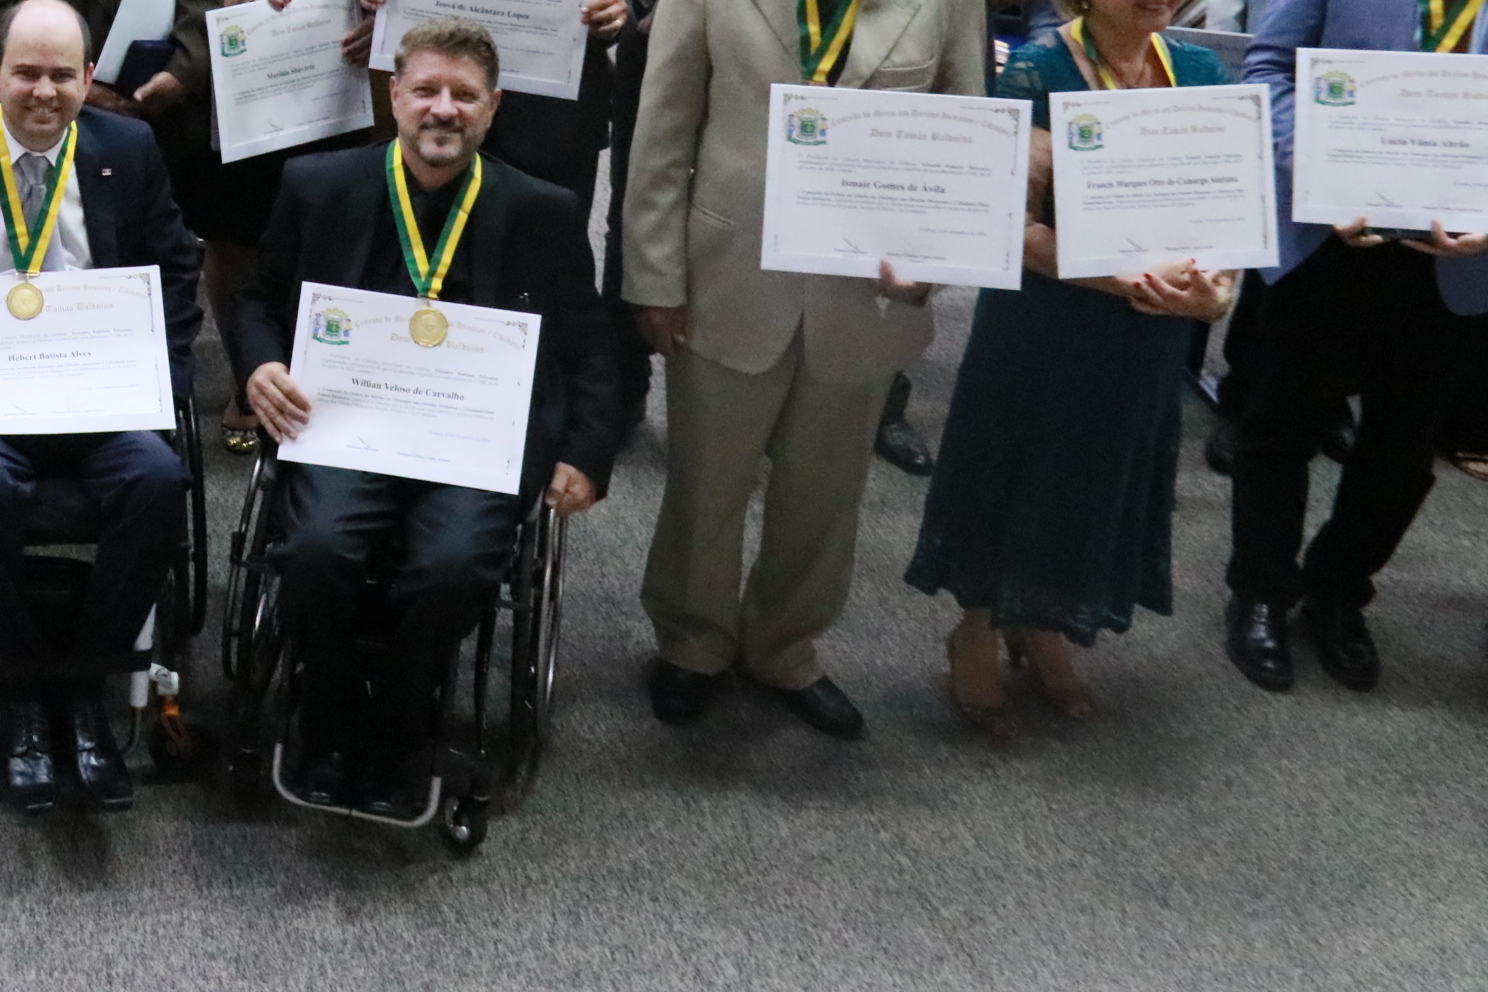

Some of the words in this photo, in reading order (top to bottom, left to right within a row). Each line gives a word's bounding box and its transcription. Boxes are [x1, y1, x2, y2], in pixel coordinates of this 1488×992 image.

[435, 0, 456, 11] Jeová
[469, 5, 505, 16] Alcântara
[507, 10, 530, 20] Lopes
[841, 179, 870, 189] Ismair
[874, 180, 905, 192] Gomes
[908, 182, 919, 192] de
[921, 182, 945, 194] Ávila
[1116, 179, 1147, 190] Marques
[1167, 178, 1175, 186] de
[1177, 177, 1208, 187] Camargo
[1210, 176, 1238, 185] Santana
[8, 353, 37, 362] Hebert
[39, 351, 68, 360] Batista
[69, 350, 92, 358] Alves
[351, 377, 382, 390] Willian
[384, 382, 411, 394] Veloso
[413, 385, 423, 395] de
[425, 388, 465, 401] Carvalho
